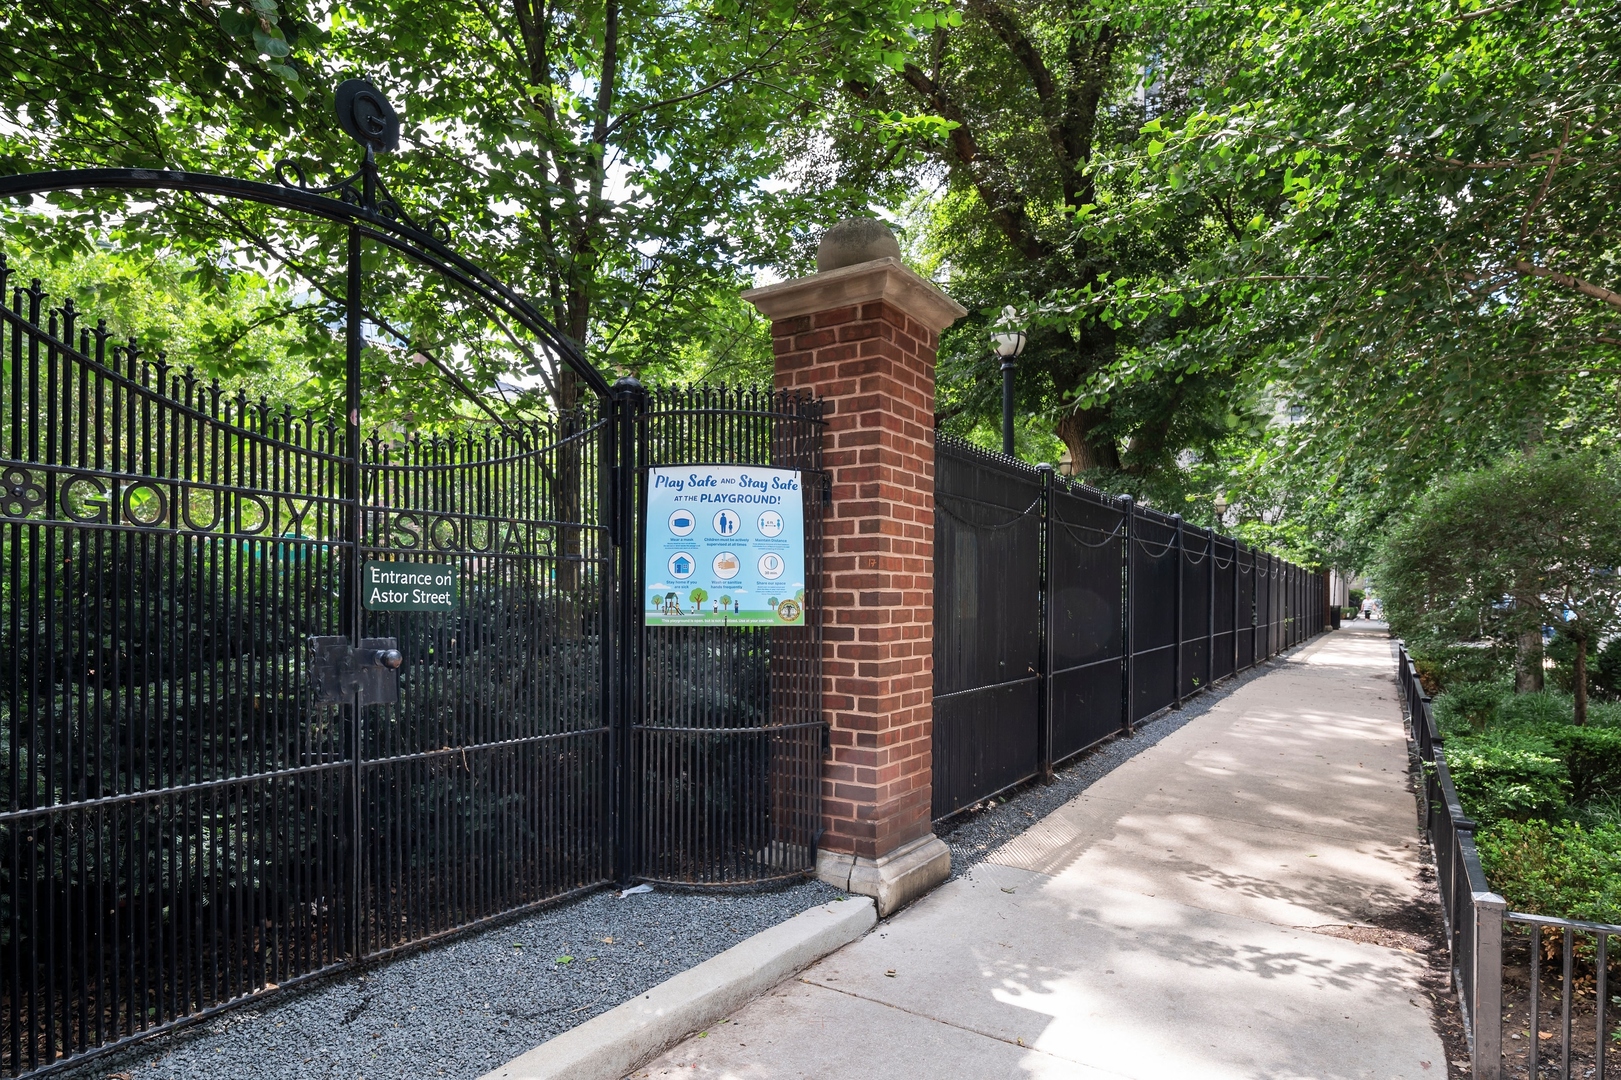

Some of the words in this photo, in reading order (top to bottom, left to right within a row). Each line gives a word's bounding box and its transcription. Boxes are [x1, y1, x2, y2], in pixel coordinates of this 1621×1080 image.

[655, 475, 684, 492] Play
[688, 474, 718, 488] Safe
[738, 474, 768, 492] Stay
[772, 476, 798, 490] Safe
[60, 474, 316, 539] GOUDY
[700, 494, 781, 504] PLAYGROUND!
[372, 568, 432, 585] Entrance
[435, 576, 452, 586] on
[370, 587, 408, 604] Astor
[412, 589, 450, 604] Street
